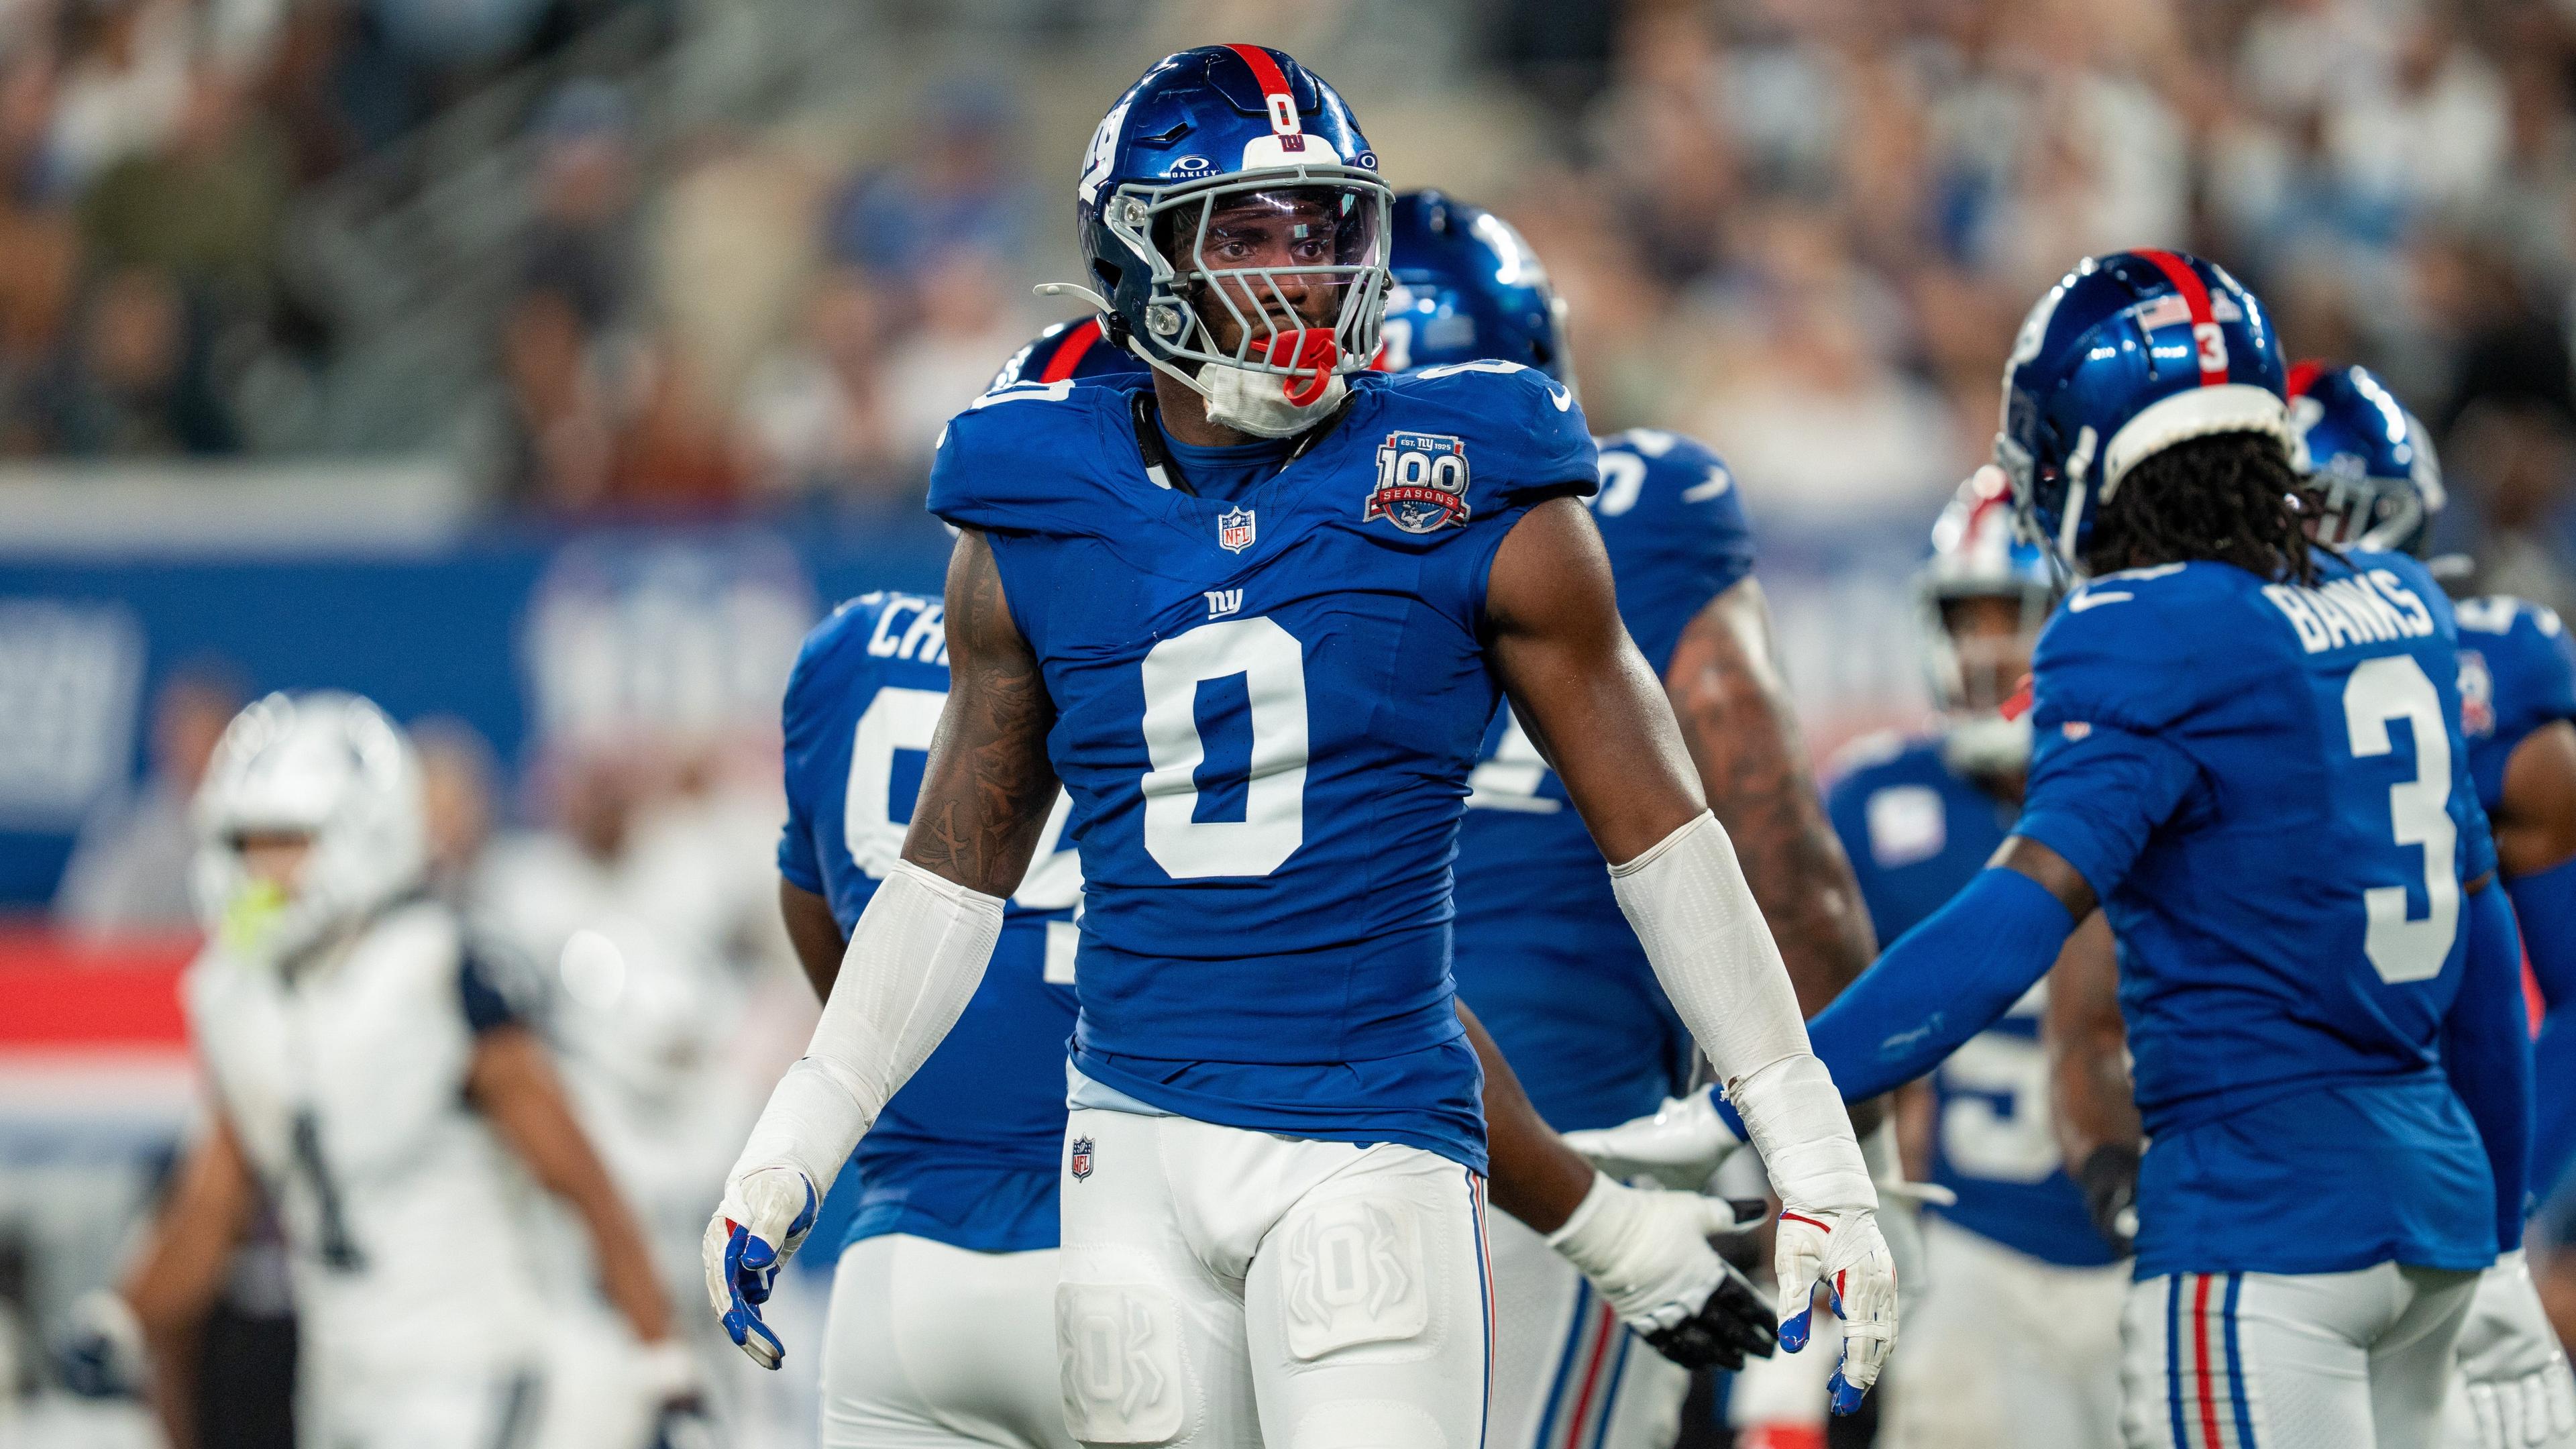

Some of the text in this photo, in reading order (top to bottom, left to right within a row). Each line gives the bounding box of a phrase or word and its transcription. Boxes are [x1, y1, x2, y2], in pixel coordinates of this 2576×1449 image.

[1267, 93, 1301, 134] 0
[1172, 170, 1218, 178] OAKLEY
[2194, 323, 2229, 373] 3
[1381, 449, 1464, 494] 100
[1384, 490, 1454, 505] SEASONS
[1225, 527, 1250, 545] NFL
[2261, 569, 2434, 653] BANKS
[1141, 616, 1309, 879] 0
[2343, 653, 2460, 984] 3
[1073, 1155, 1089, 1174] NFL
